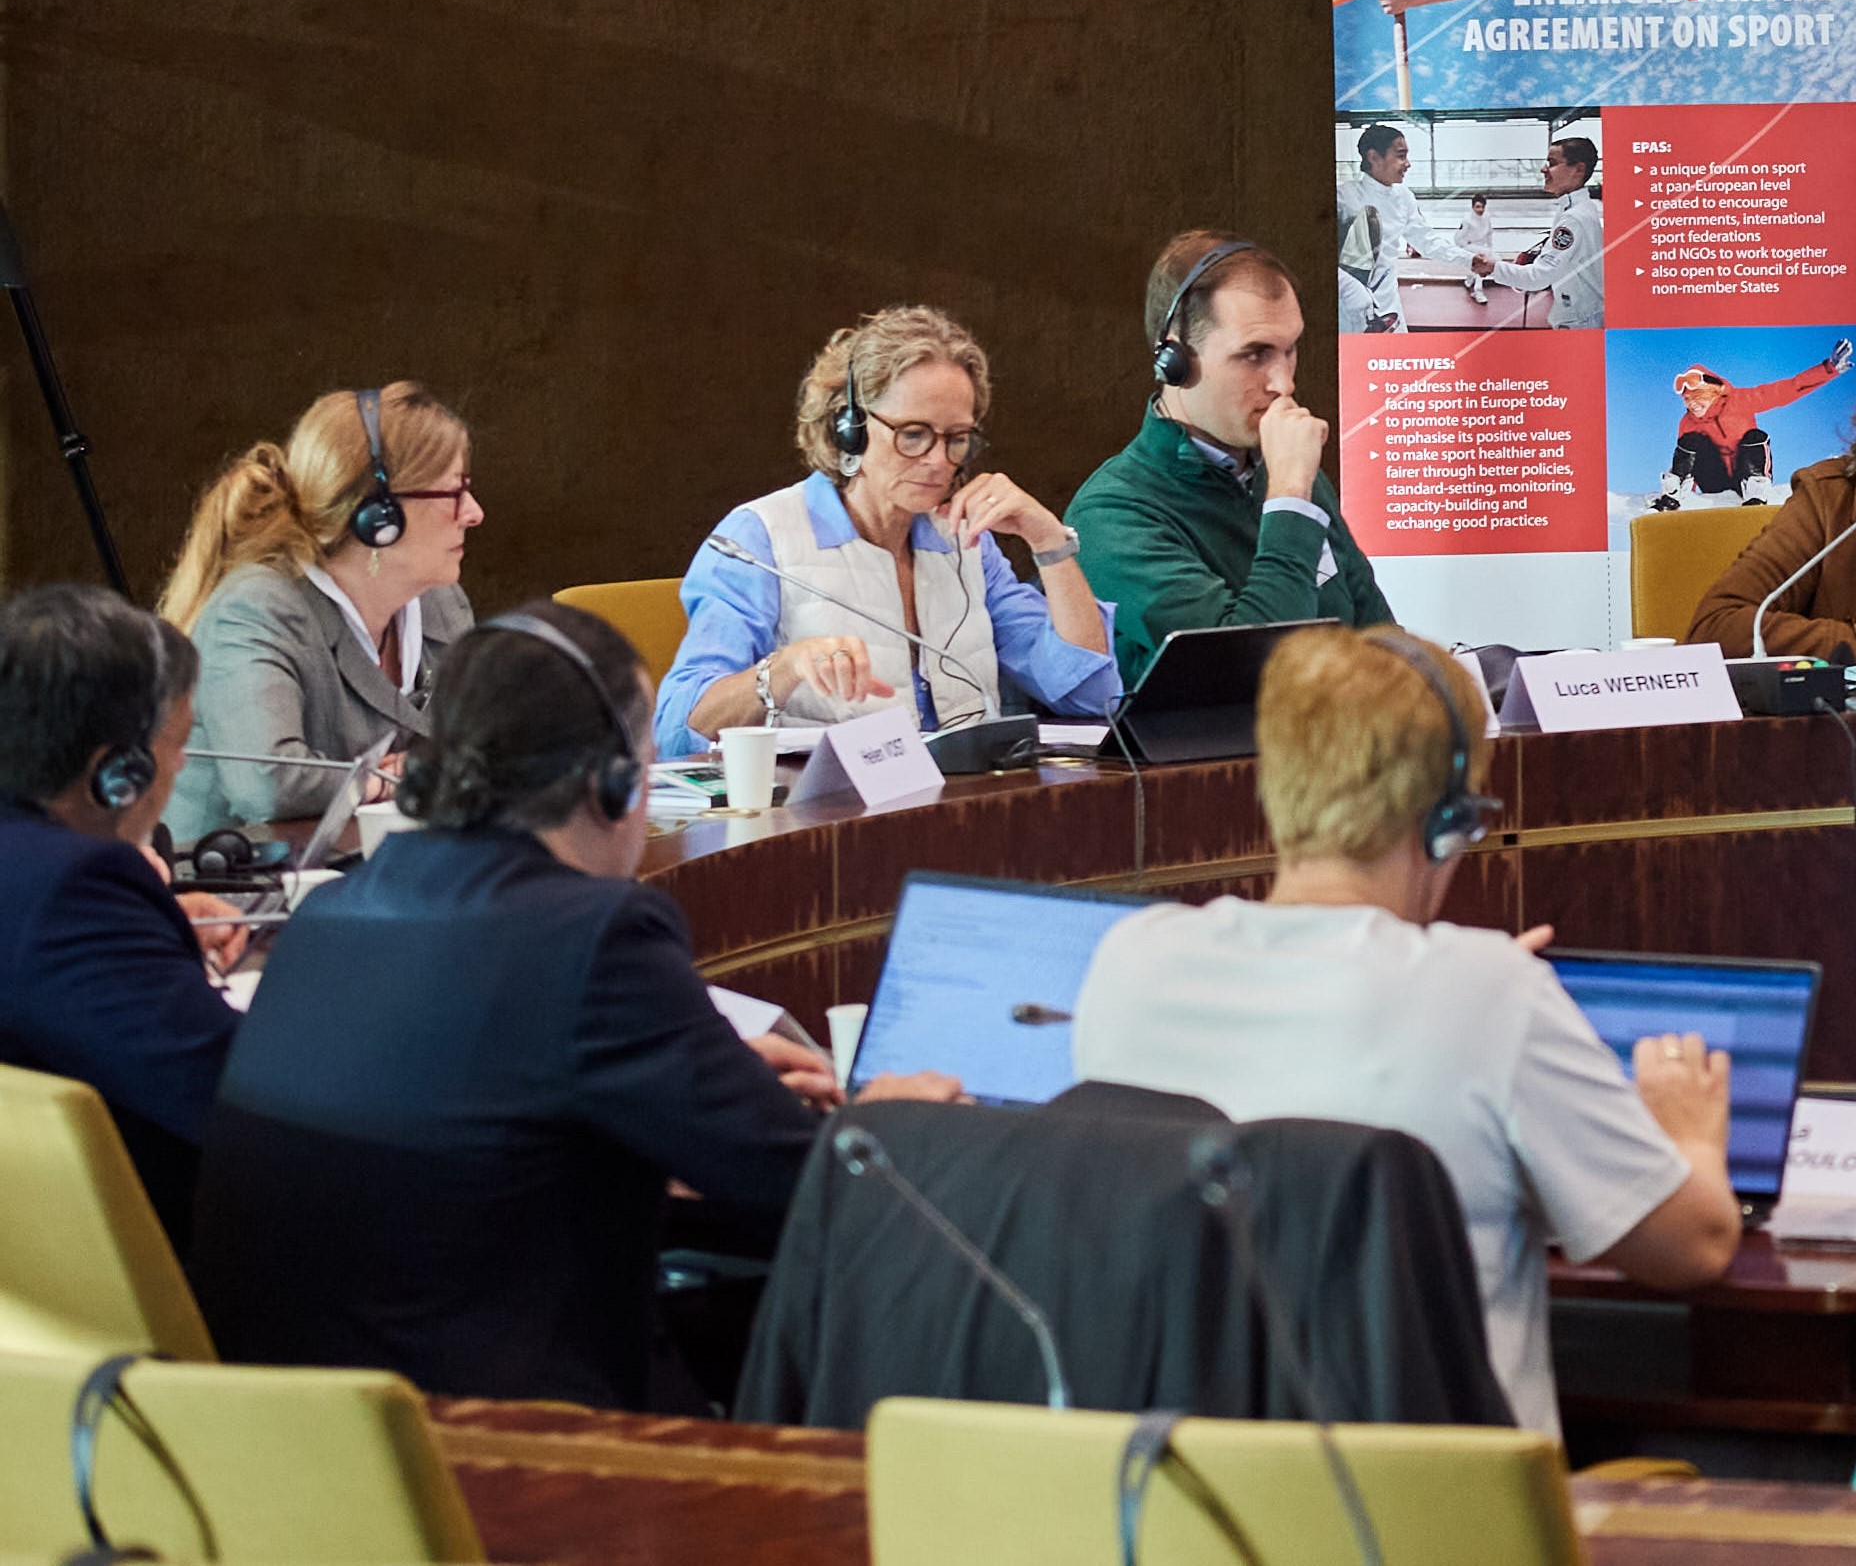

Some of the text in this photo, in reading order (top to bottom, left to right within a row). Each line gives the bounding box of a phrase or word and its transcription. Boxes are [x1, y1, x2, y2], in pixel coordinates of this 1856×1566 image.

[1462, 13, 1835, 53] AGREEMENT ON SPORT
[1632, 142, 1672, 153] EPAS:
[1650, 162, 1806, 177] a unique forum on sport
[1650, 179, 1790, 195] at pan-European level
[1651, 197, 1787, 210] created to encourage
[1651, 211, 1825, 229] governments, international
[1651, 230, 1761, 246] sport federations
[1651, 246, 1827, 261] and NGOs to work together
[1652, 262, 1847, 279] also open to Council of Europe
[1652, 281, 1779, 294] non-member States
[1368, 358, 1455, 371] OBJECTIVES:
[1385, 379, 1548, 393] to address the challenges
[1385, 395, 1567, 413] facing sport in Europe today
[1386, 413, 1524, 429] to promote sport and
[1386, 429, 1571, 447] emphasise its positive values
[1386, 446, 1564, 462] to make sport healthier and
[1386, 463, 1573, 479] fairer through better policies,
[1386, 480, 1575, 496] standard-setting, monitoring,
[1387, 497, 1527, 513] capacity-building and
[1387, 515, 1548, 531] exchange good practices
[1555, 671, 1699, 696] Luca WERNERT
